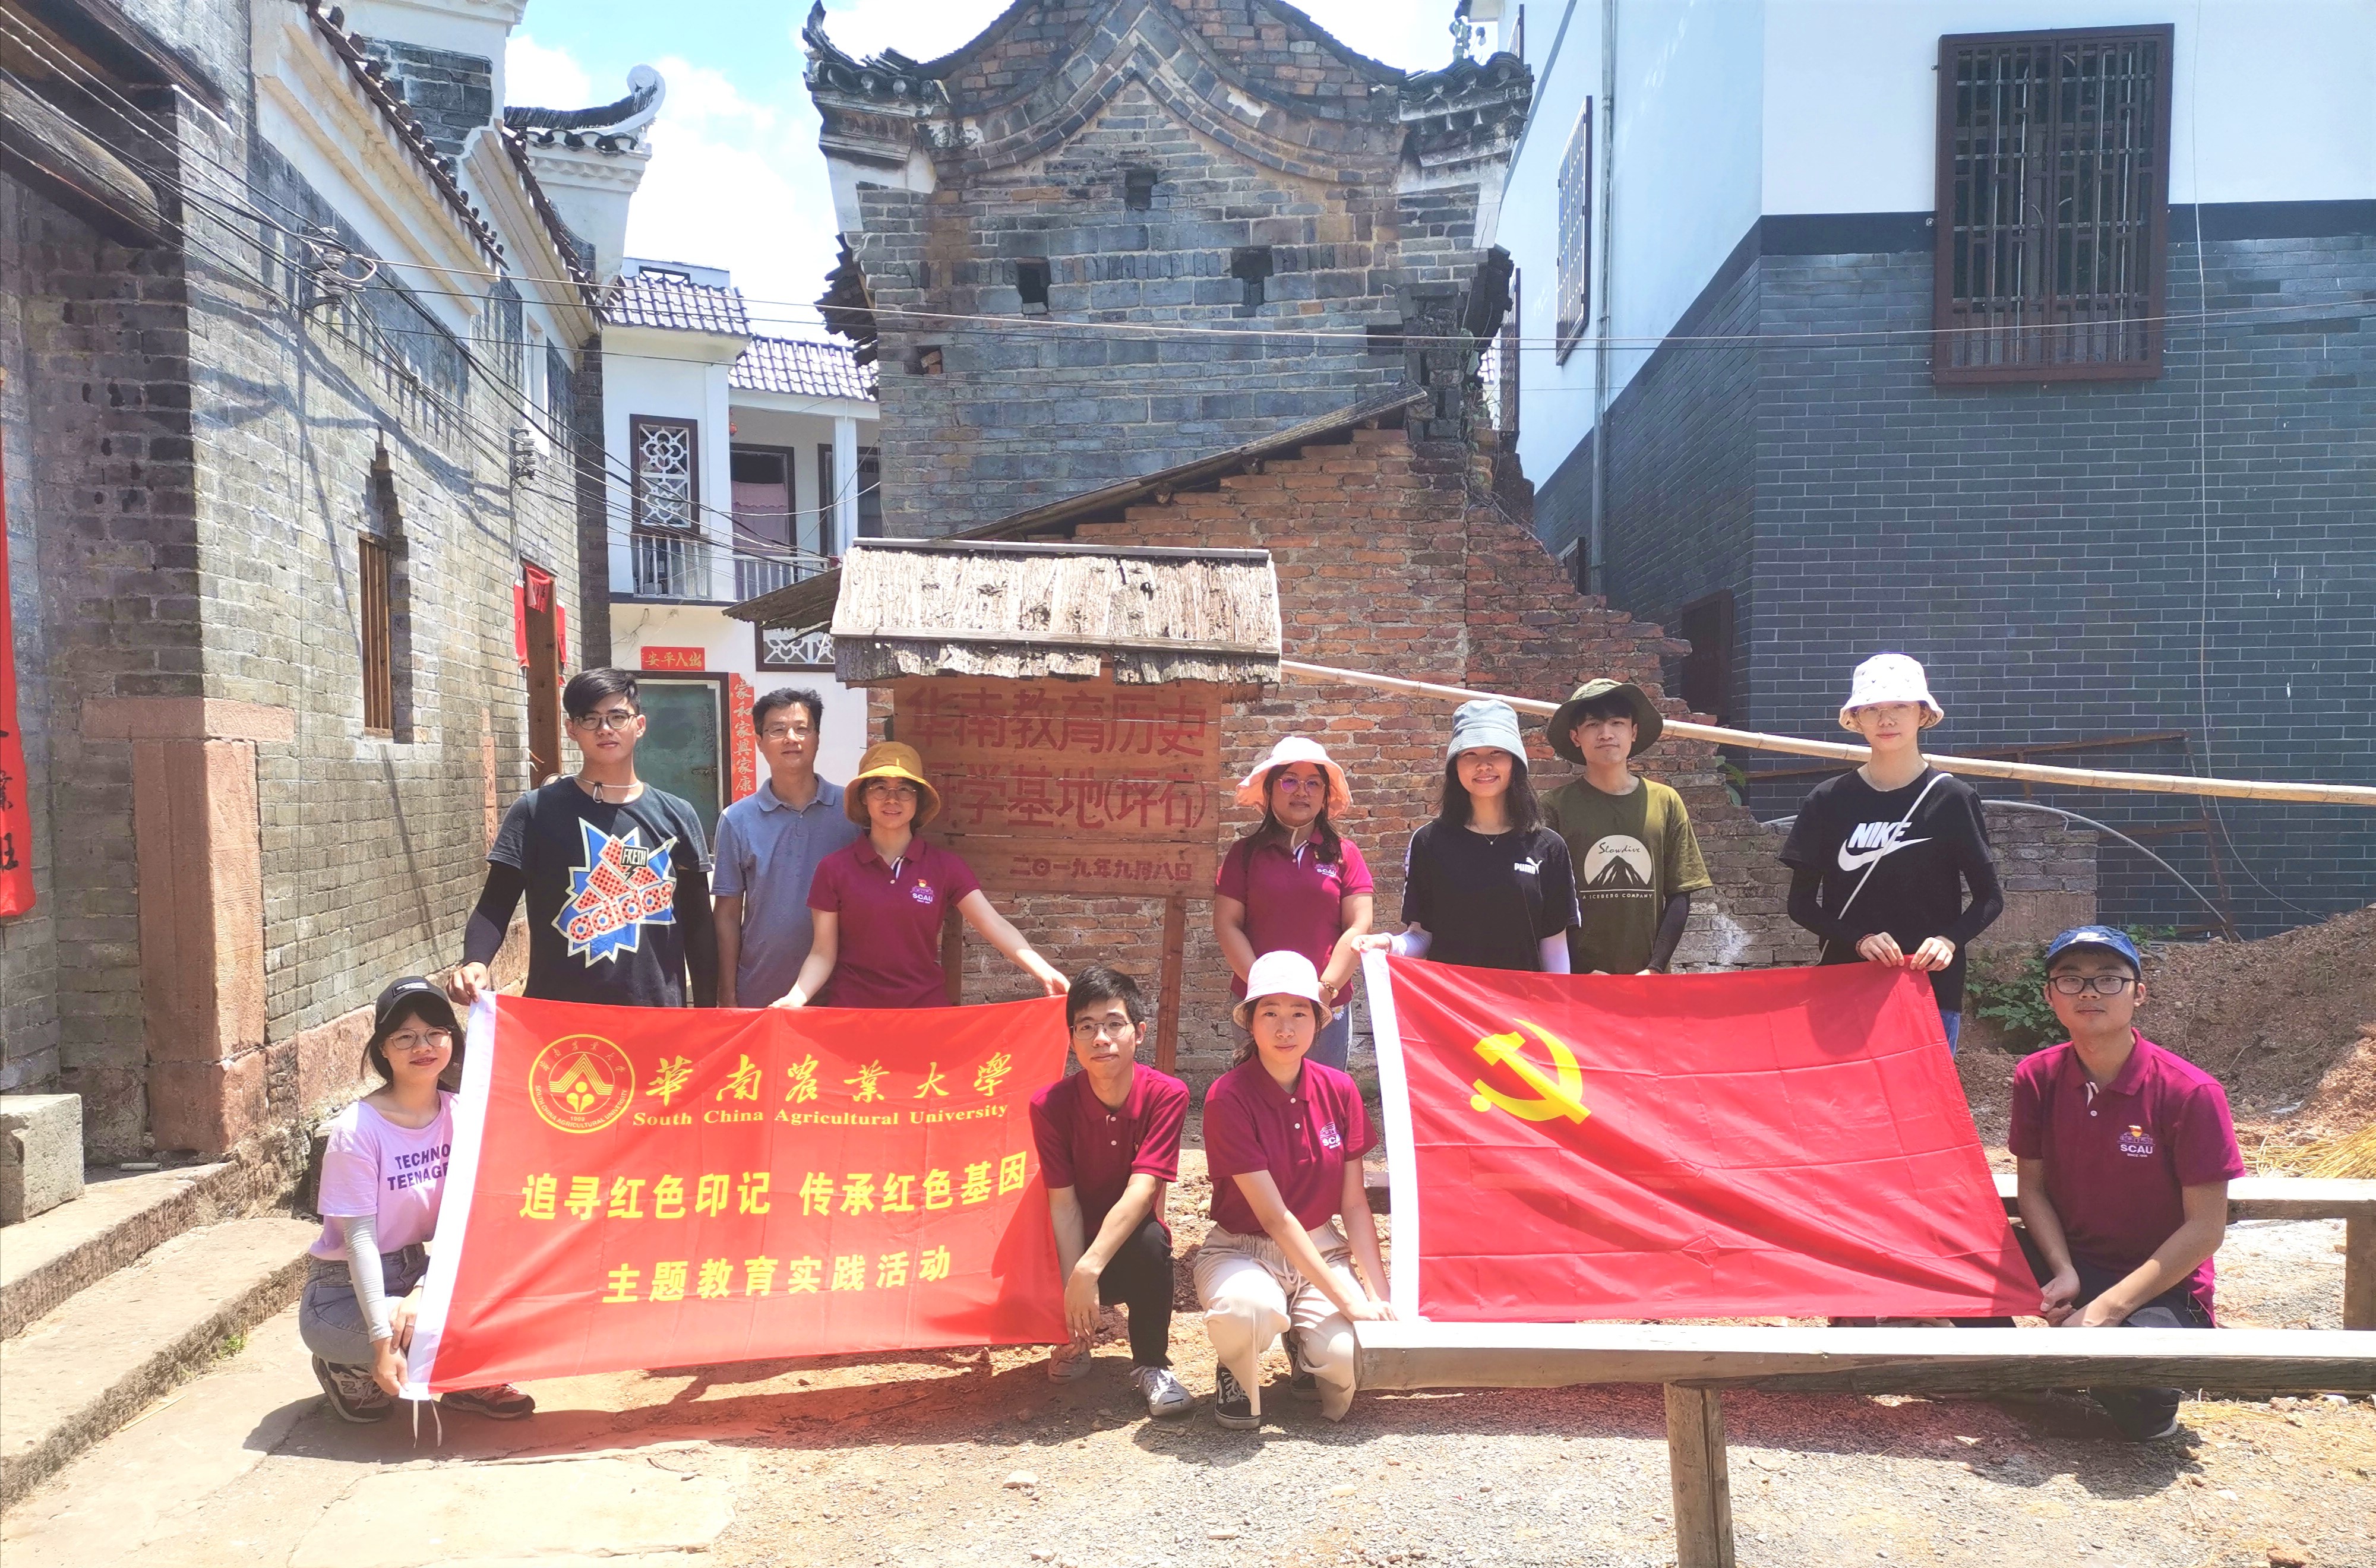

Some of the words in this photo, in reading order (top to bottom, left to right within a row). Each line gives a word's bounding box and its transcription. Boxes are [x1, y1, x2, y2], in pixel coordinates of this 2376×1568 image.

[733, 680, 754, 798] 家和家興家康
[905, 687, 1207, 756] 华南教育历史
[1598, 842, 1641, 854] Slowdive
[1847, 821, 1912, 848] NIKE
[1514, 862, 1536, 874] PUMA
[568, 883, 673, 942] adidas
[912, 893, 933, 902] SCAU
[535, 1085, 545, 1105] SOUTH
[541, 1105, 557, 1121] CHINA
[556, 1118, 605, 1128] AGRICULTURAL
[604, 1089, 627, 1120] UNIVERSITY
[633, 1112, 692, 1126] South
[704, 1109, 764, 1123] China
[775, 1108, 898, 1125] Agricultural
[909, 1104, 1008, 1124] University
[2120, 1144, 2153, 1154] SCAU
[519, 1171, 770, 1221] 追寻红色印记
[800, 1151, 1026, 1216] 传承红色基因
[602, 1245, 950, 1303] 主题教育实践活动
